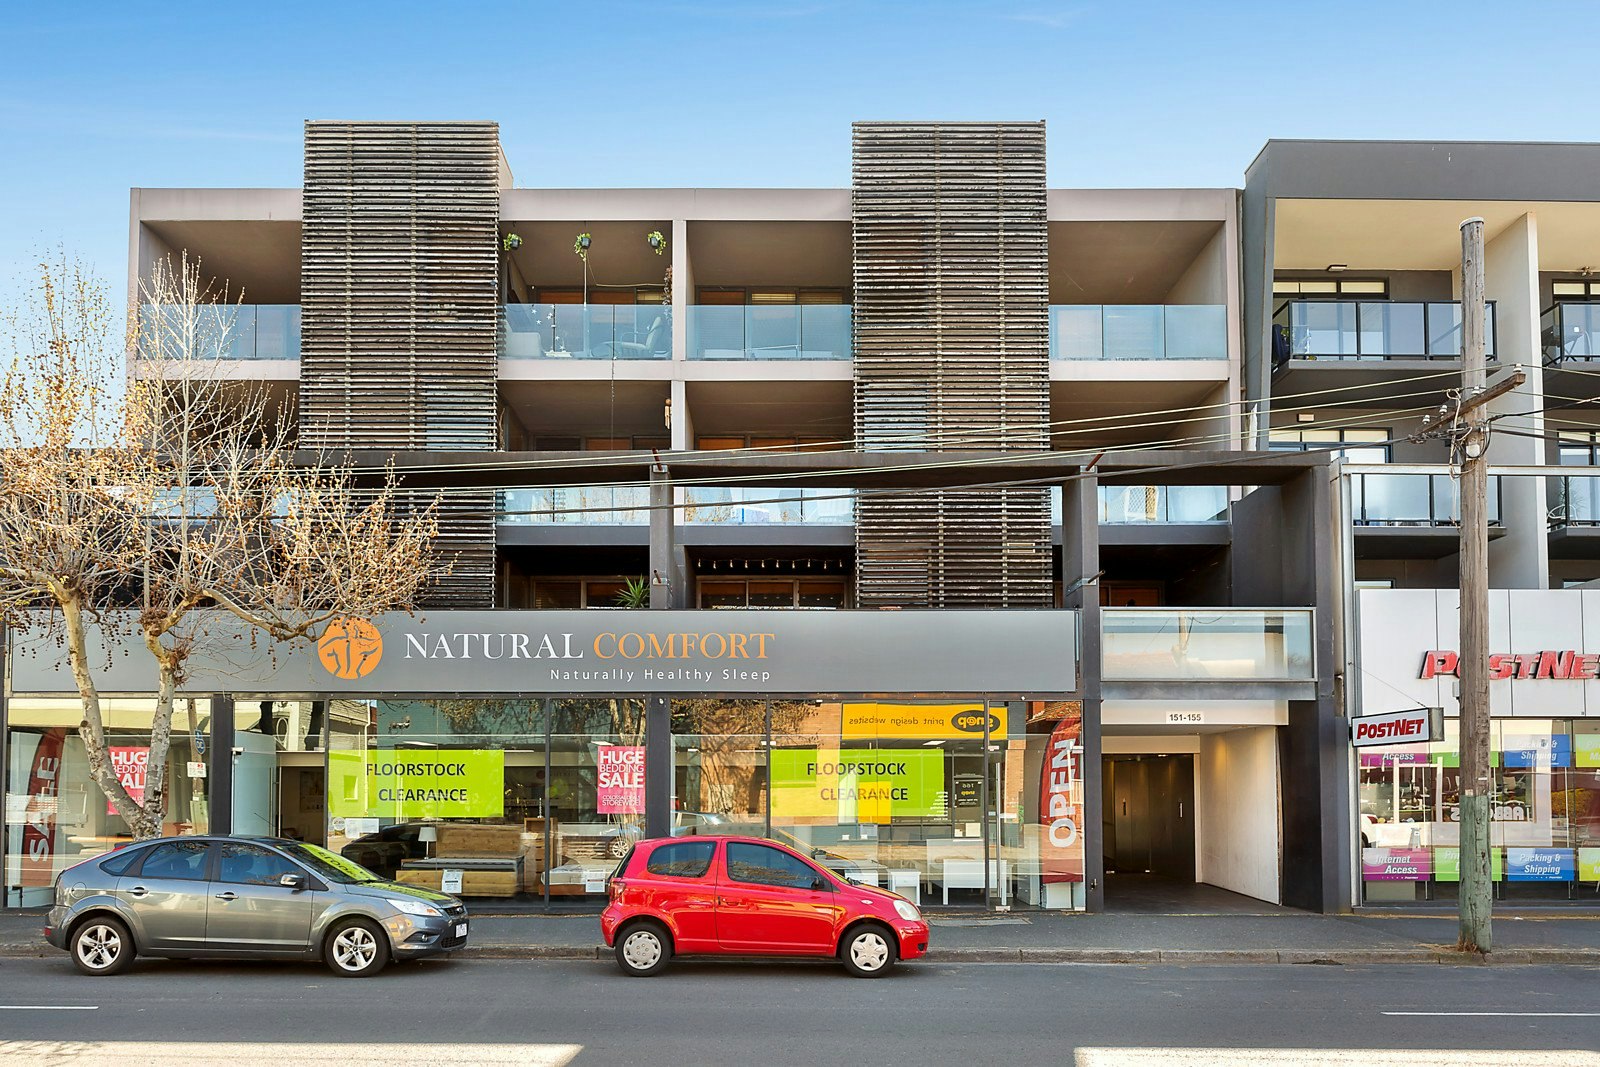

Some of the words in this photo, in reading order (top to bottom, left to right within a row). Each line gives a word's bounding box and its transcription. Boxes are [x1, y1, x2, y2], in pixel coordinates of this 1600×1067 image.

[403, 633, 584, 660] NATURAL
[593, 632, 775, 659] COMFORT
[550, 669, 634, 682] Naturally
[644, 669, 713, 682] Healthy
[722, 669, 771, 682] Sleep
[1169, 713, 1202, 721] 151-155
[599, 751, 645, 764] HUGE
[1383, 752, 1415, 761] Access
[366, 763, 466, 776] FLOORSTOCK
[599, 763, 645, 773] BEDDING
[807, 762, 906, 776] FLOORSTOCK
[598, 772, 645, 788] SALE
[378, 788, 468, 801] CLEARANCE
[820, 787, 909, 801] CLEARANCE
[1048, 737, 1077, 849] OPEN
[1375, 855, 1411, 864] Internet
[1520, 853, 1552, 864] Packing
[1554, 853, 1561, 862] &
[1384, 864, 1418, 874] Access
[1524, 864, 1561, 875] Shipping
